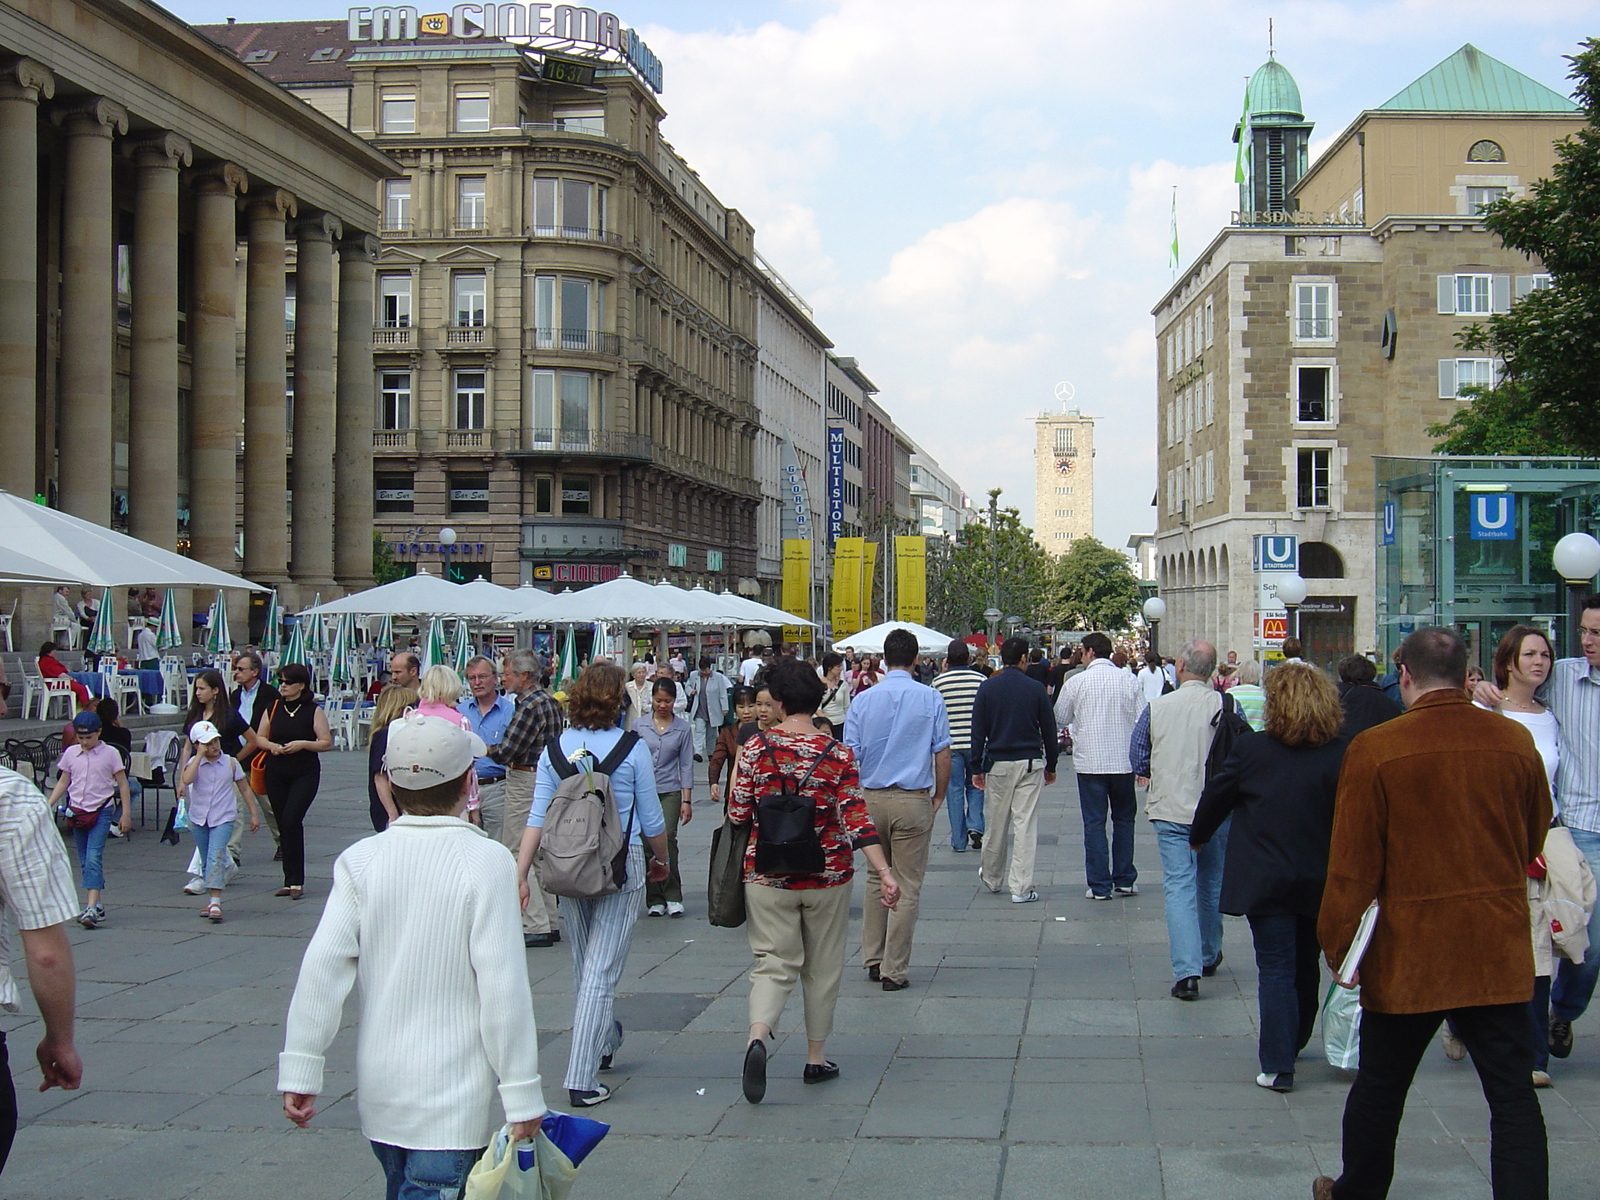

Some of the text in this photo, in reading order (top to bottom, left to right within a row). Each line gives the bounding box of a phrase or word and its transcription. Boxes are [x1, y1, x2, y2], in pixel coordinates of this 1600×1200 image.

[348, 3, 620, 49] EM CINEMA
[548, 62, 584, 82] 16:37
[1231, 211, 1365, 225] DRESDNER BANK
[1385, 504, 1394, 535] U
[1478, 497, 1507, 529] U
[1267, 537, 1291, 563] U
